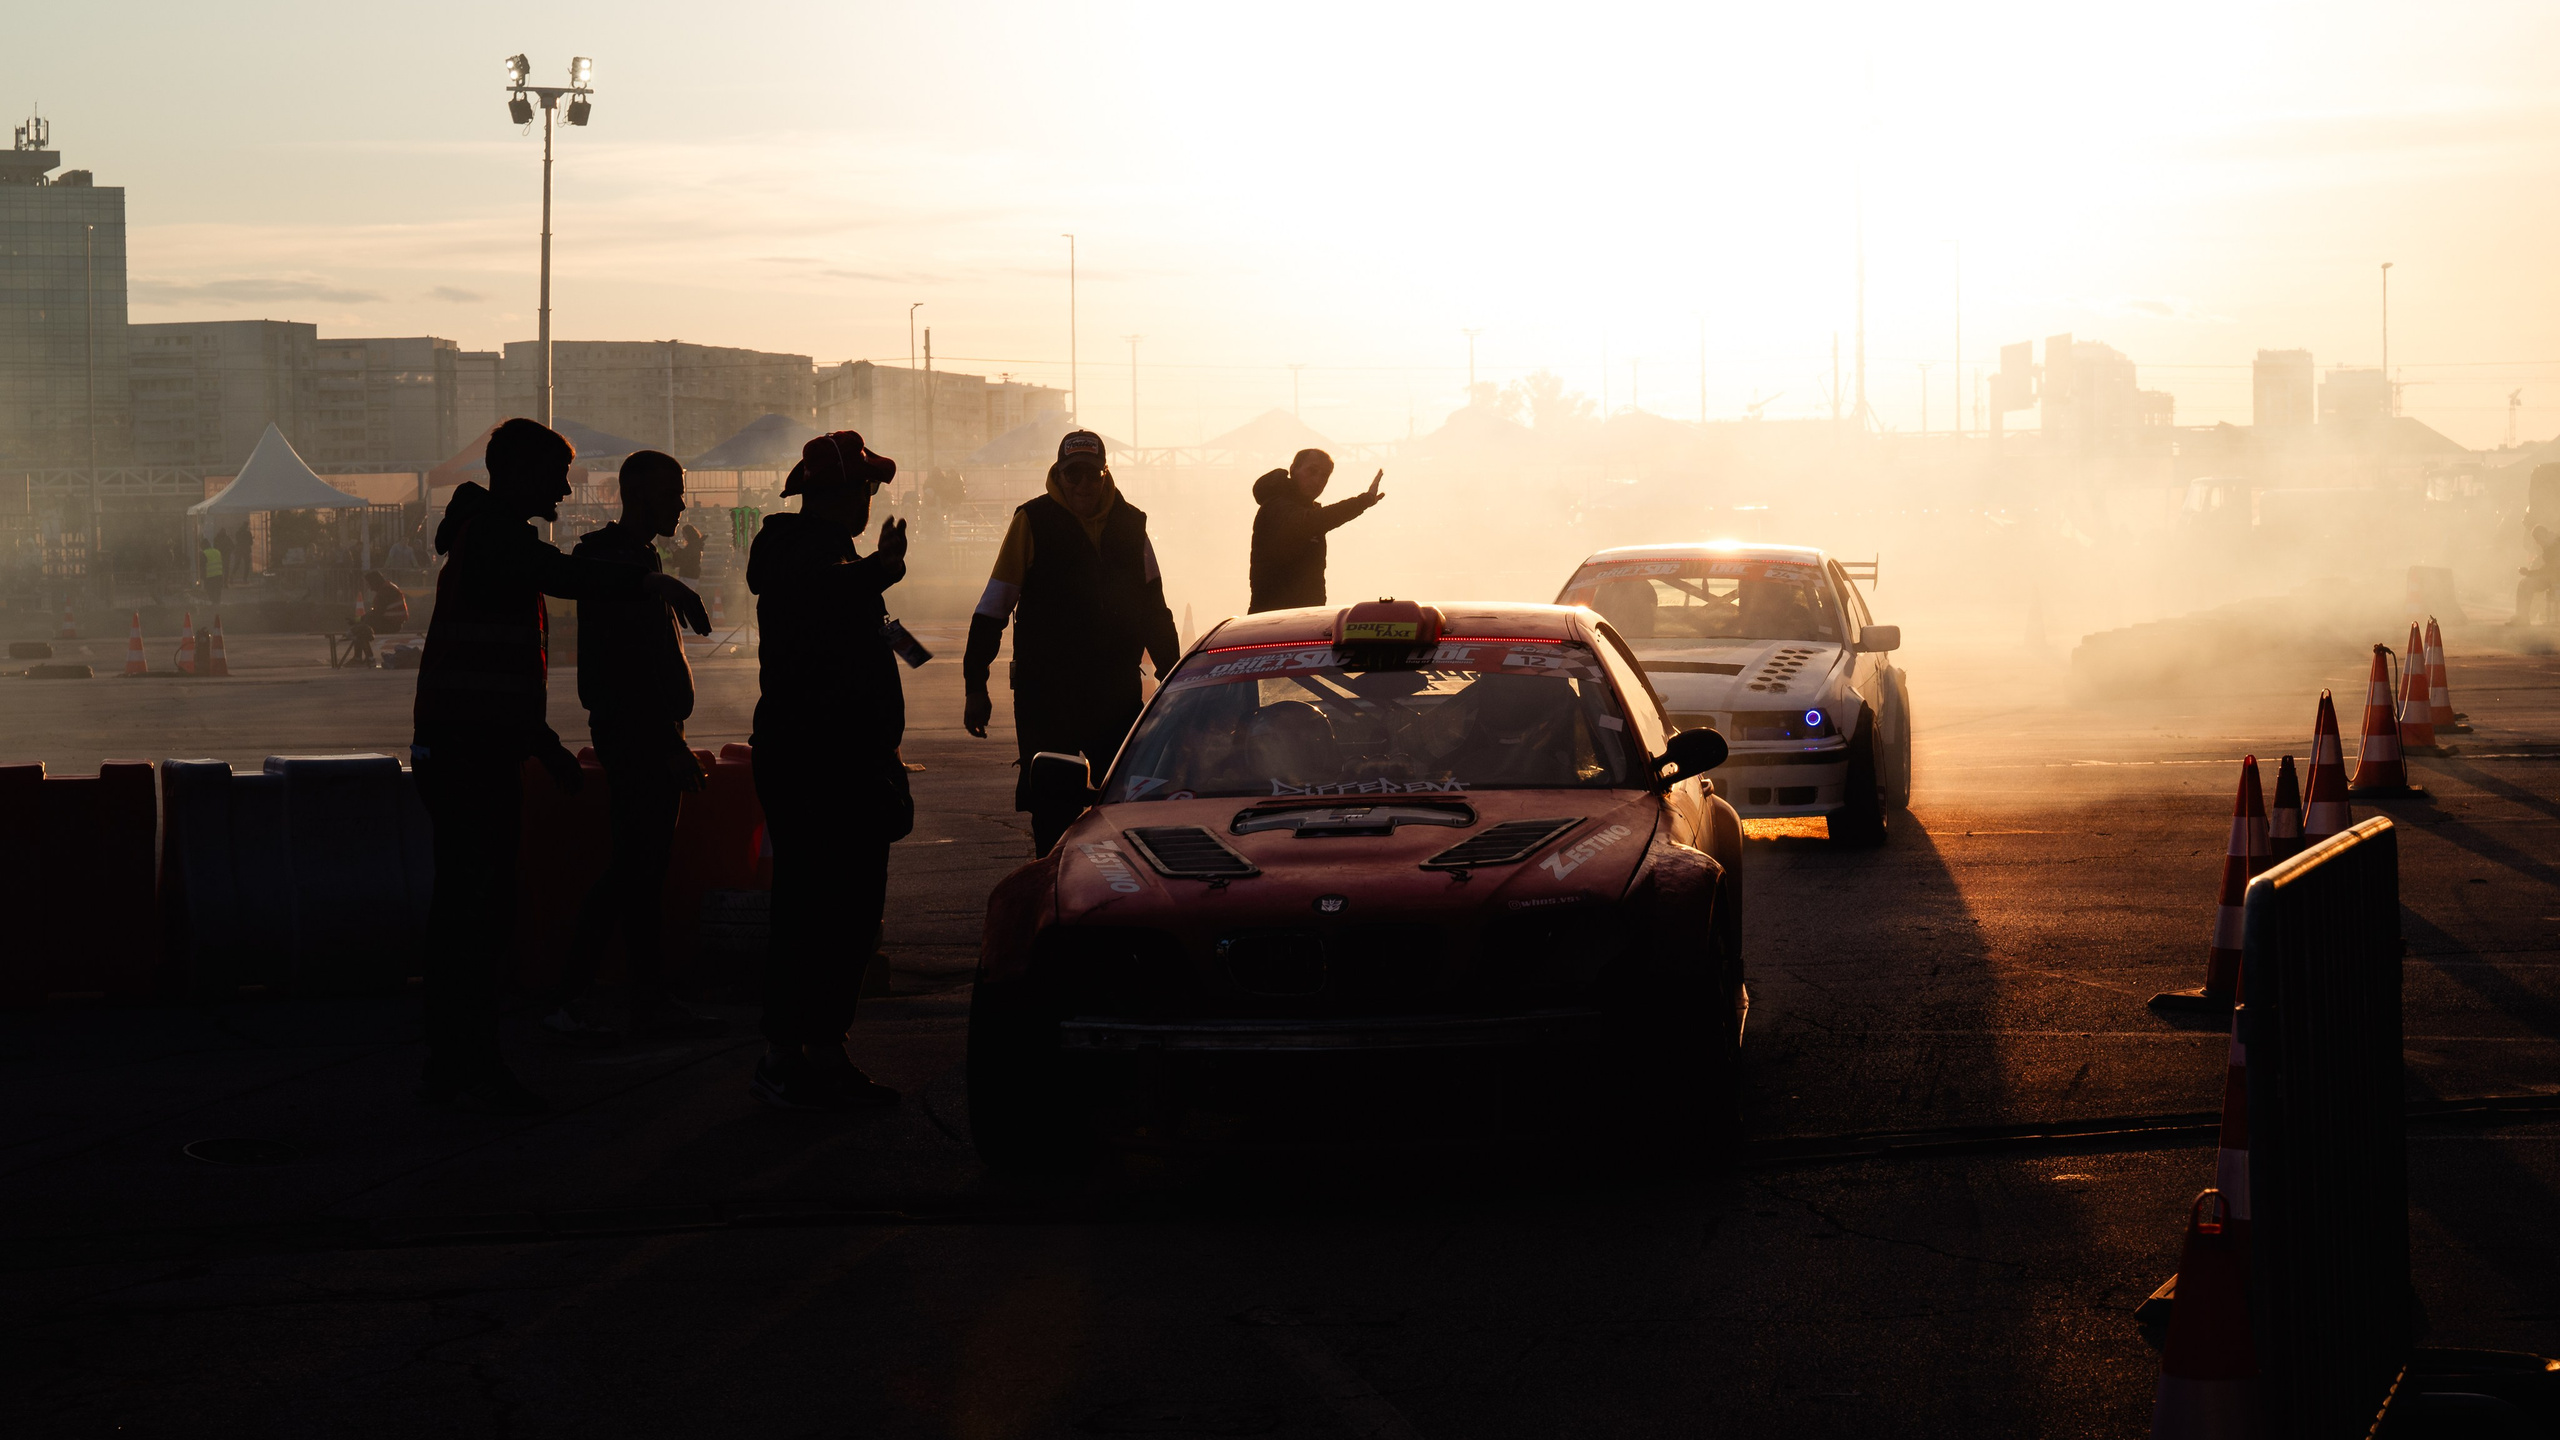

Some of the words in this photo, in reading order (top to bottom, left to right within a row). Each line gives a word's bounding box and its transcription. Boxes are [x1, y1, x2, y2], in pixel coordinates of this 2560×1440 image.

[1345, 623, 1396, 632] DRIFT
[1375, 630, 1411, 638] TAXI
[1210, 656, 1290, 675] DRIFT
[1285, 650, 1354, 671] SDC
[1520, 655, 1547, 667] 12
[1183, 664, 1284, 683] CHAMPIONSHIP
[1538, 823, 1633, 882] ZESTINO
[1076, 839, 1141, 893] ZESTINO
